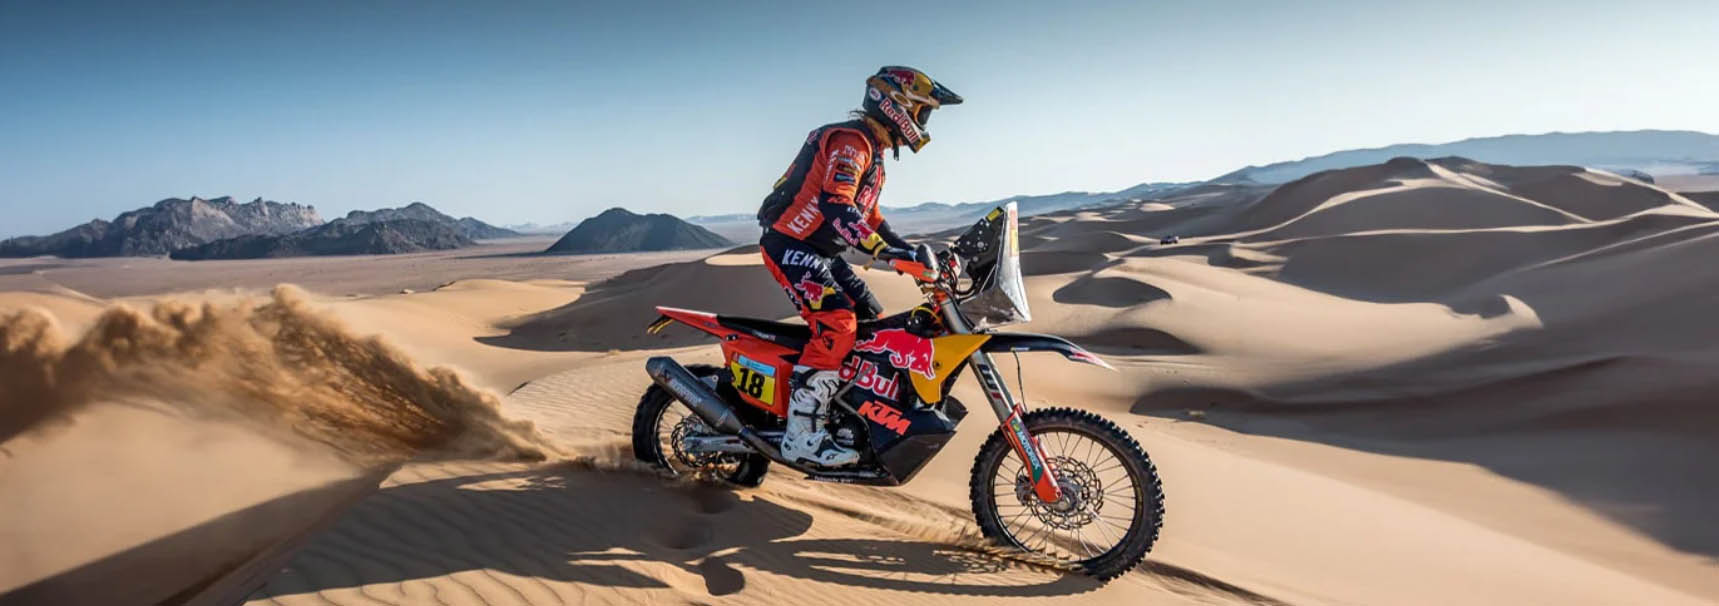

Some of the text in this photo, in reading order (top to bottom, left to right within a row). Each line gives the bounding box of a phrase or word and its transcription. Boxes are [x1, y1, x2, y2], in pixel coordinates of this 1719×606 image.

[880, 97, 920, 144] Red Bull
[786, 196, 820, 234] KENNY
[782, 249, 832, 272] KENNY
[737, 367, 766, 399] 18
[857, 400, 912, 436] KTM
[1016, 431, 1042, 470] MOTOREX
